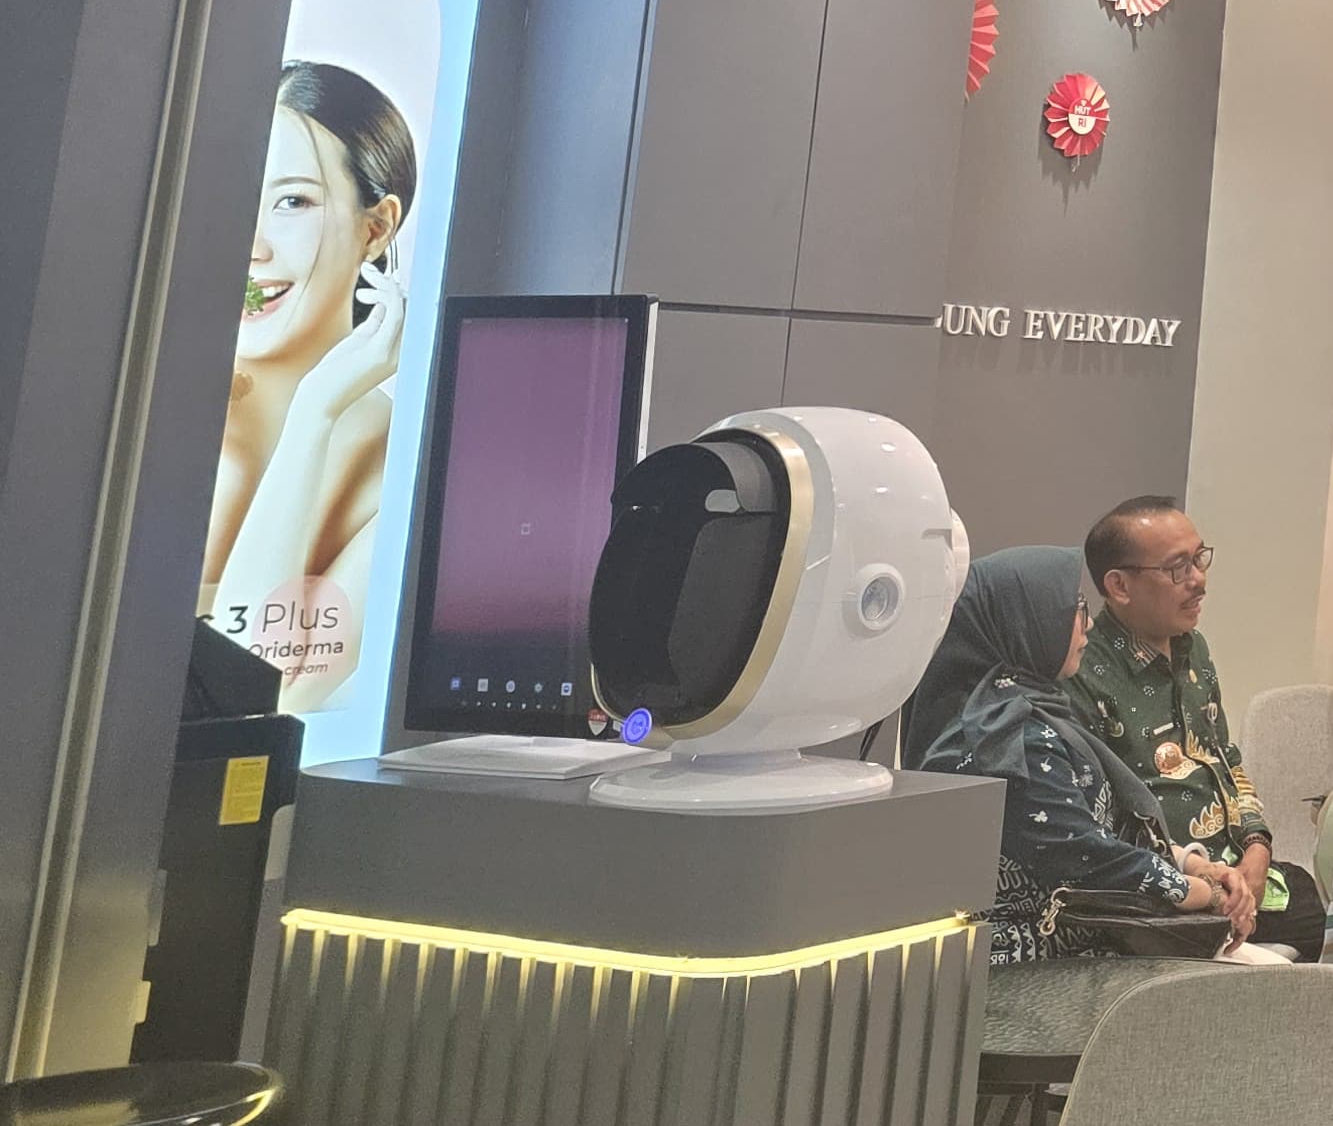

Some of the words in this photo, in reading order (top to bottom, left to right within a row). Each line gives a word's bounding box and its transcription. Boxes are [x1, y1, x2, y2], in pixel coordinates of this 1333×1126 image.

[1074, 105, 1091, 115] HUT
[1078, 117, 1087, 127] RI
[934, 304, 1010, 337] UNG
[1021, 309, 1182, 347] EVERYDAY
[226, 605, 249, 634] 3
[262, 601, 338, 633] Plus
[284, 663, 329, 675] cream
